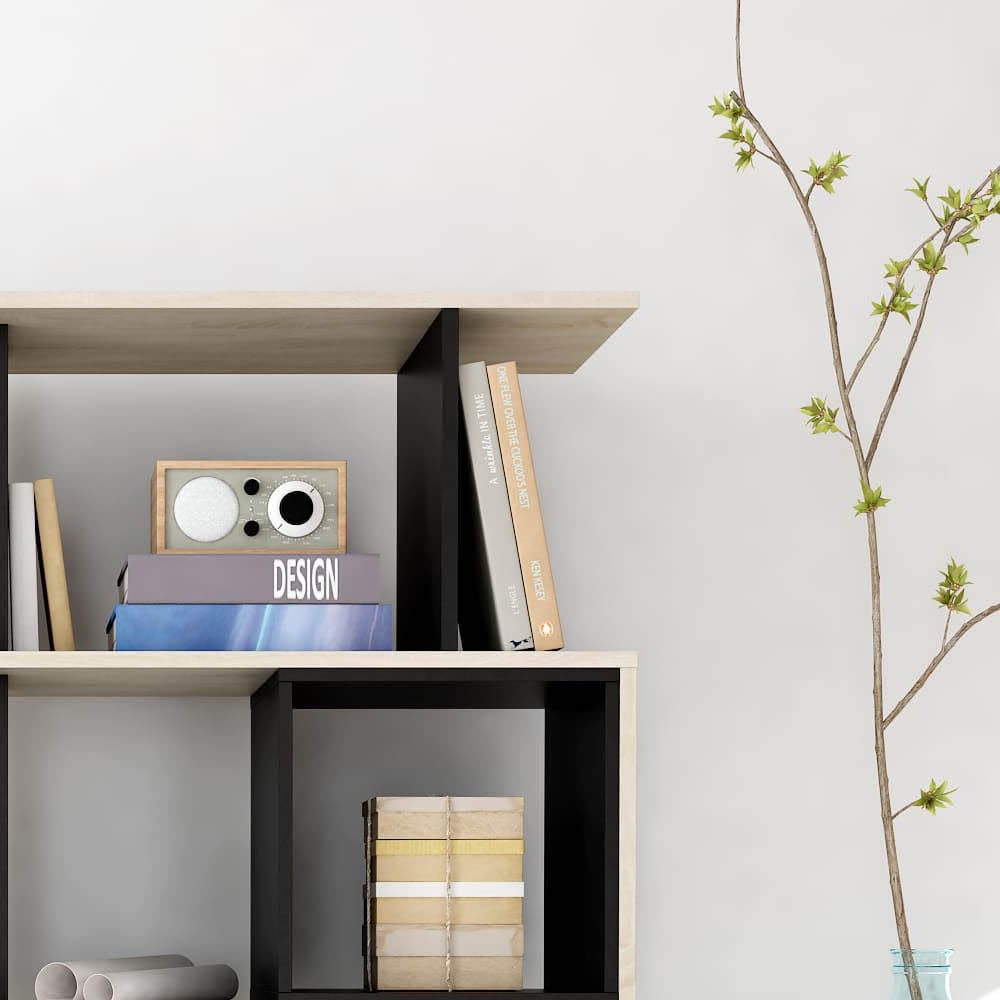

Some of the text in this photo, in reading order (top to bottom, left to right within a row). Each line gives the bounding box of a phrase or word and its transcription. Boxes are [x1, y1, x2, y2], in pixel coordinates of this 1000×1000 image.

[474, 392, 487, 418] TIME
[500, 384, 513, 407] FLEW
[479, 420, 490, 433] IN
[503, 407, 517, 429] OVER
[507, 429, 519, 446] THE
[518, 488, 530, 509] NEST
[530, 560, 542, 576] KEN
[273, 557, 339, 601] DESIGN
